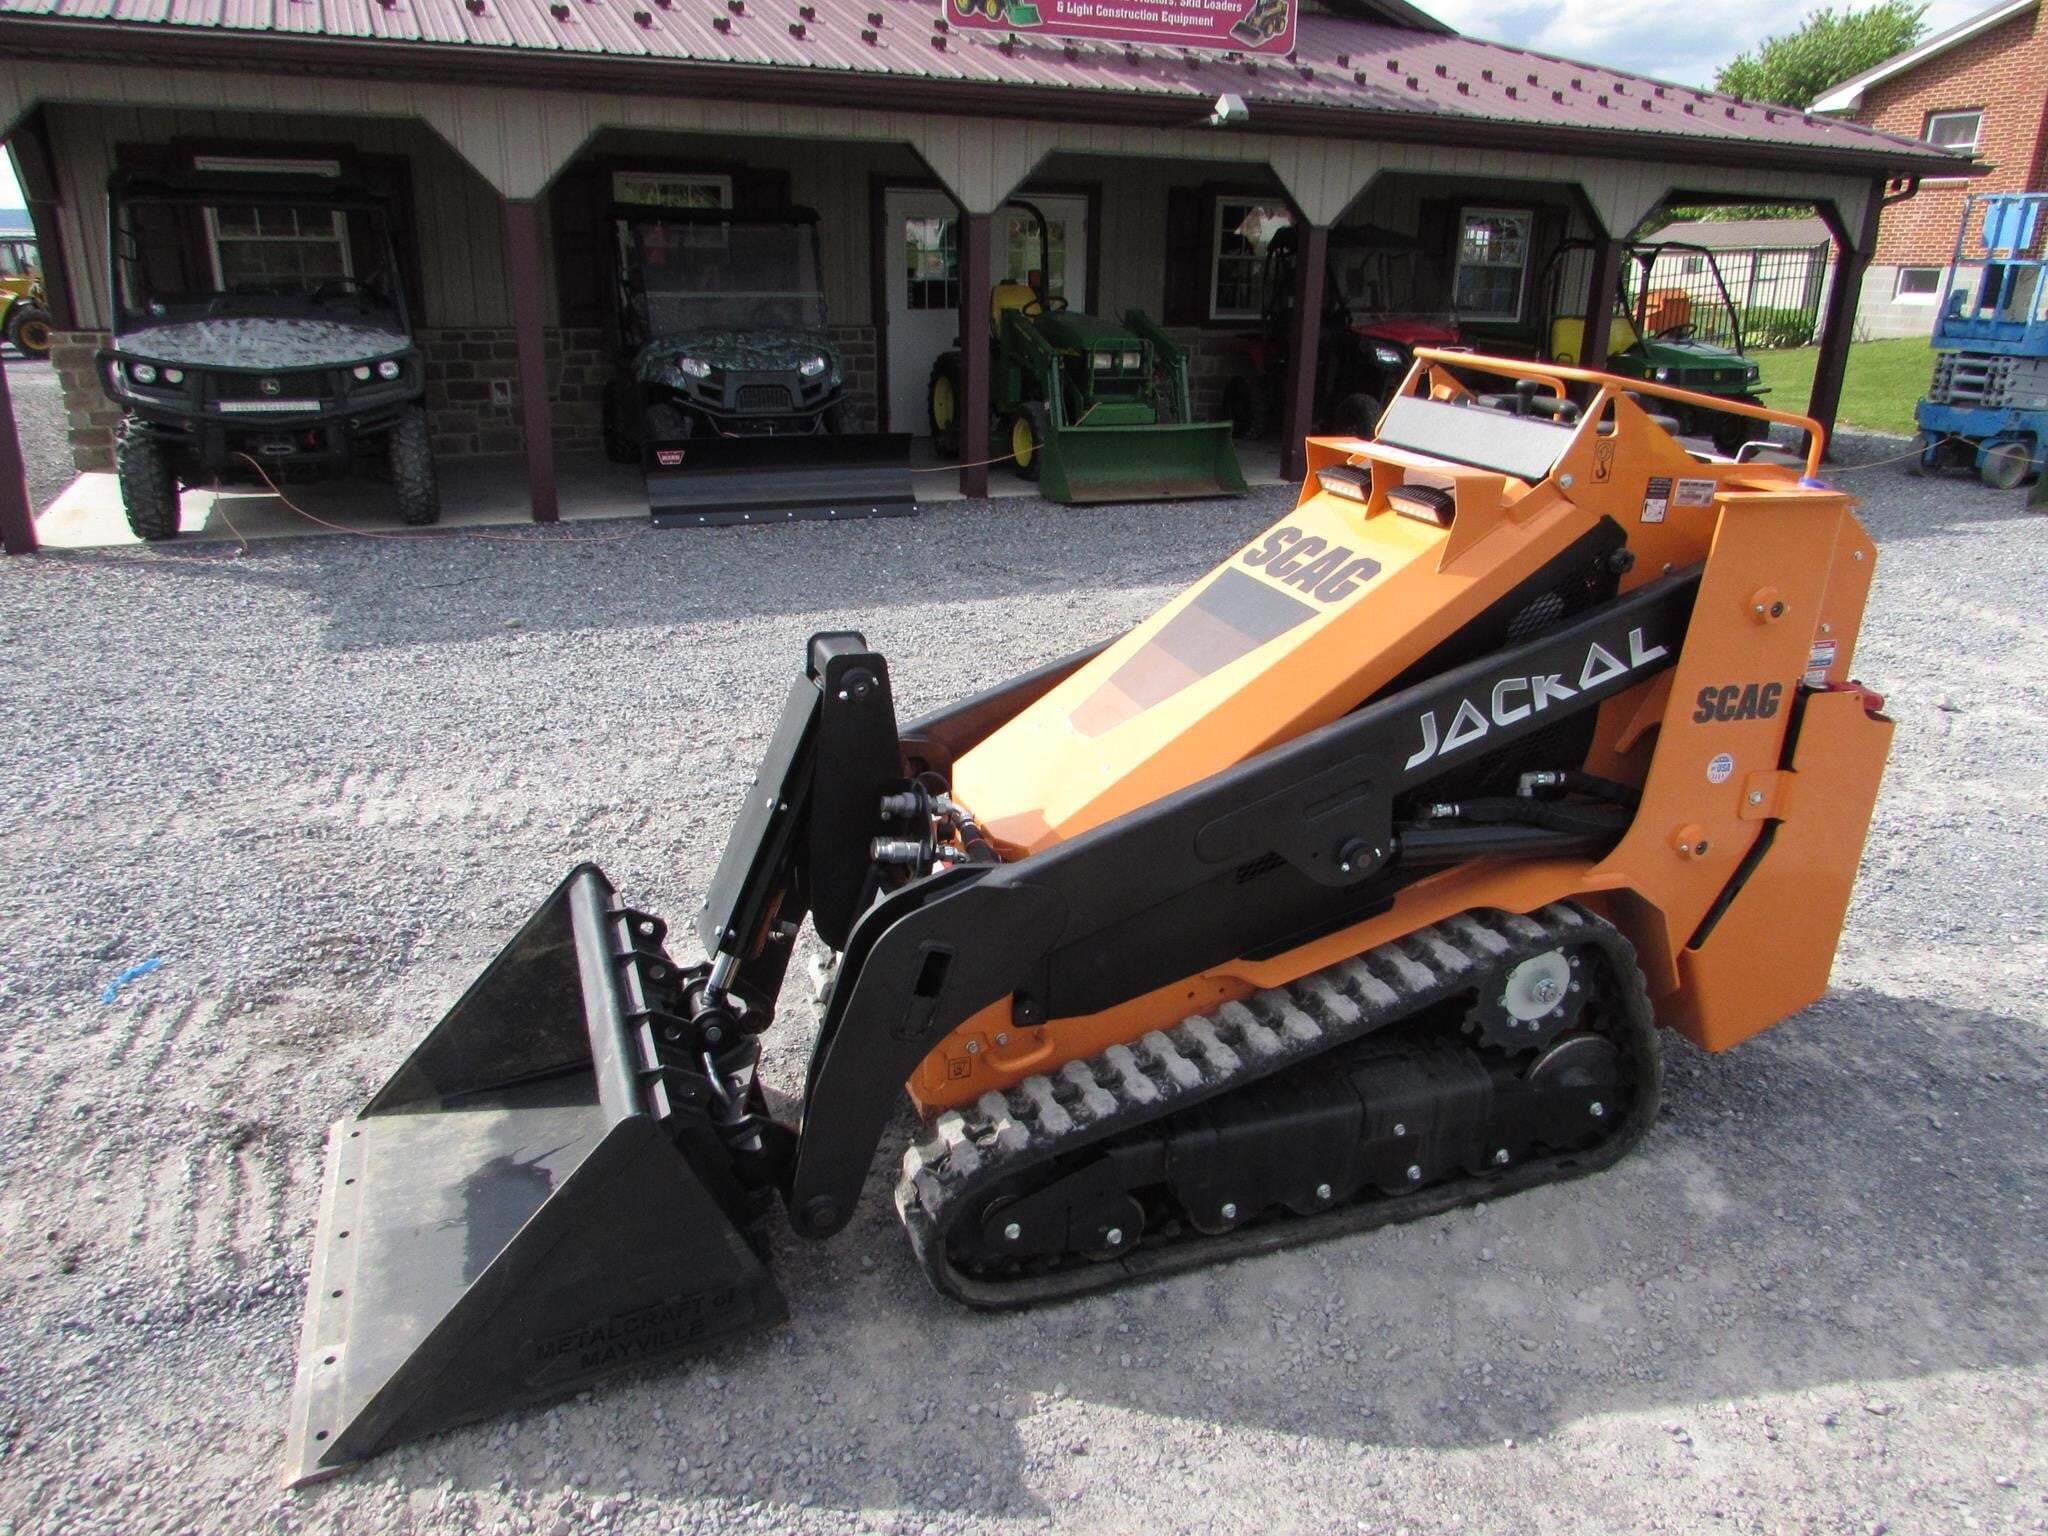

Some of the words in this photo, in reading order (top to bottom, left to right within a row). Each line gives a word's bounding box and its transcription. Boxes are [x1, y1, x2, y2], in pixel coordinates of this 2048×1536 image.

[1057, 1, 1064, 13] &
[1067, 2, 1093, 17] Light
[1096, 5, 1159, 21] Construction
[1162, 11, 1213, 27] Equipment
[1180, 0, 1201, 8] Skid
[1204, 0, 1242, 12] Loaders
[1243, 526, 1381, 603] SCAG
[1404, 627, 1668, 770] JACKAL
[1692, 683, 1783, 723] SCAG
[536, 1294, 707, 1361] METALCRAFT
[581, 1320, 704, 1369] MAYVILLE
